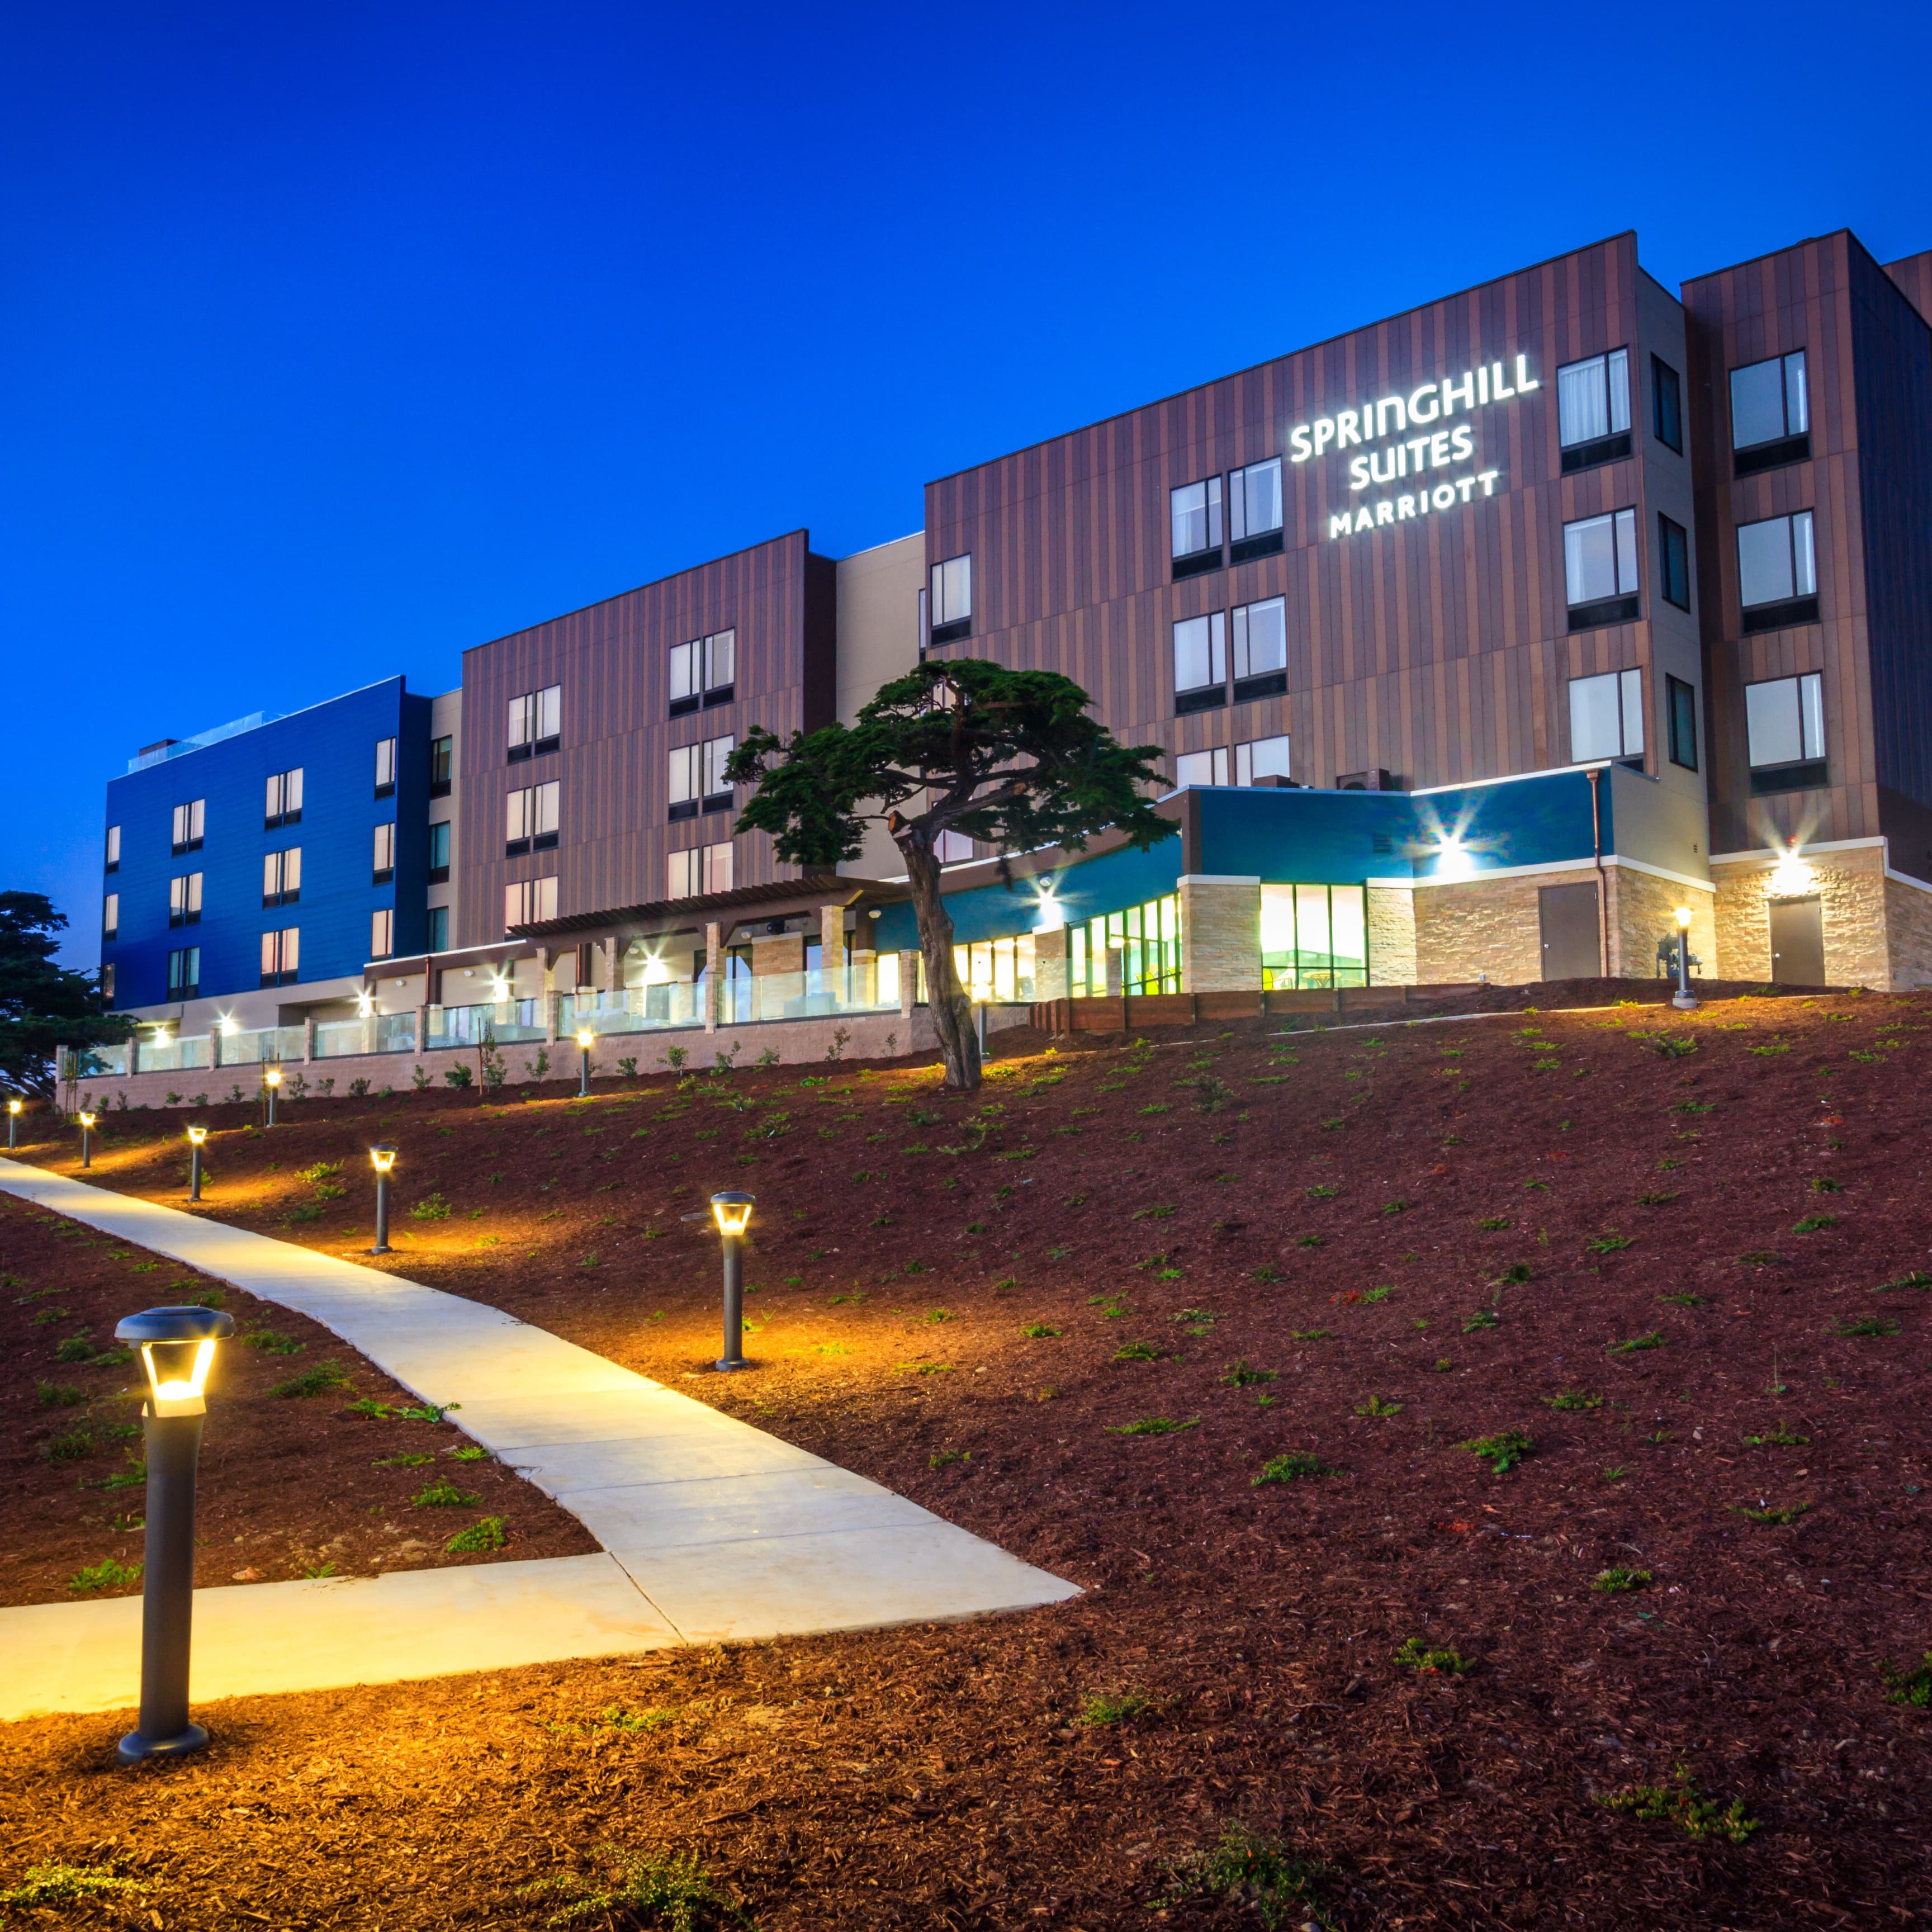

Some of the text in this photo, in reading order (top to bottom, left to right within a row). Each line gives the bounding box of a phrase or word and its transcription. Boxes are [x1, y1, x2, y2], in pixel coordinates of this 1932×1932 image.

[1290, 353, 1540, 463] SPRINGHILL
[1349, 424, 1474, 491] SUITES
[1329, 470, 1499, 539] MARRIOTT
